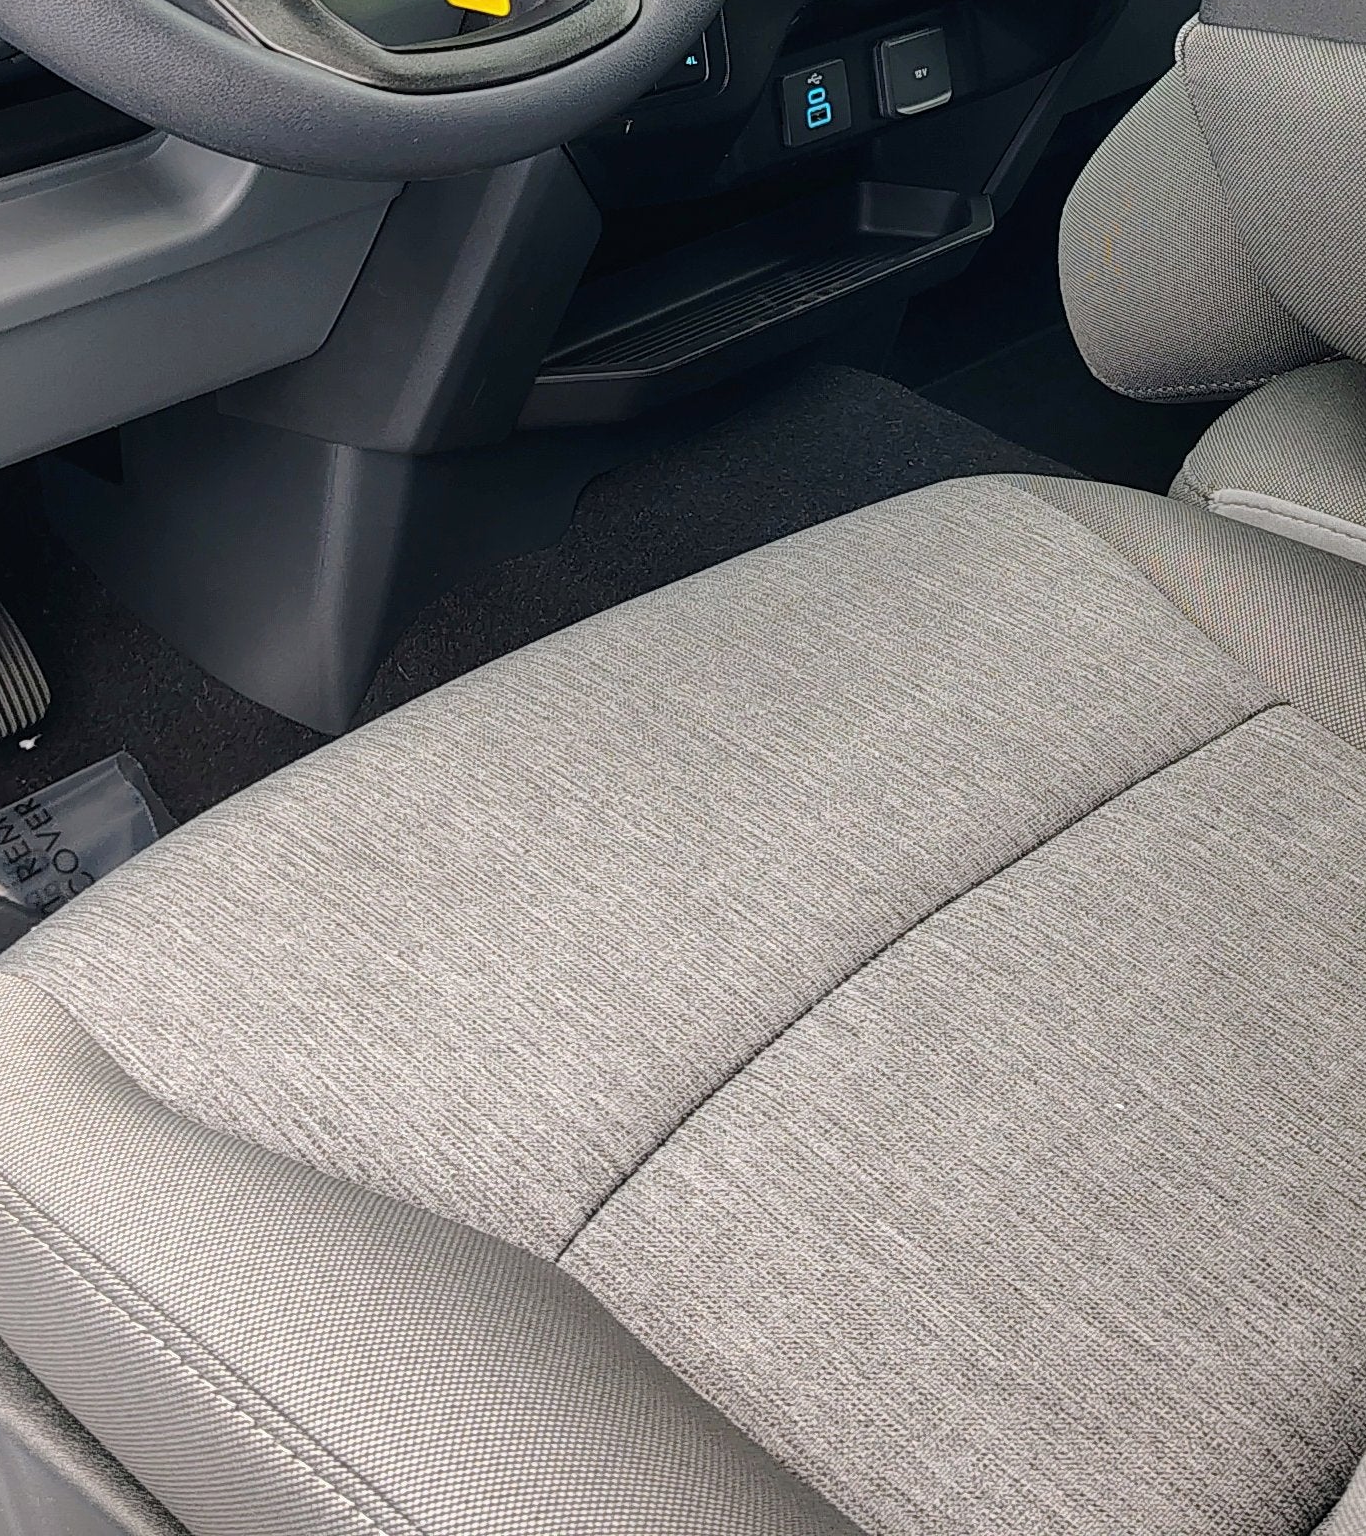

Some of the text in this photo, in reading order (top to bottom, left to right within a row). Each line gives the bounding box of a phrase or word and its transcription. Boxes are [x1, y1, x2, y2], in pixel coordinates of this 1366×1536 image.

[685, 55, 698, 65] 4L
[914, 67, 929, 79] 12V
[14, 797, 96, 896] COVER
